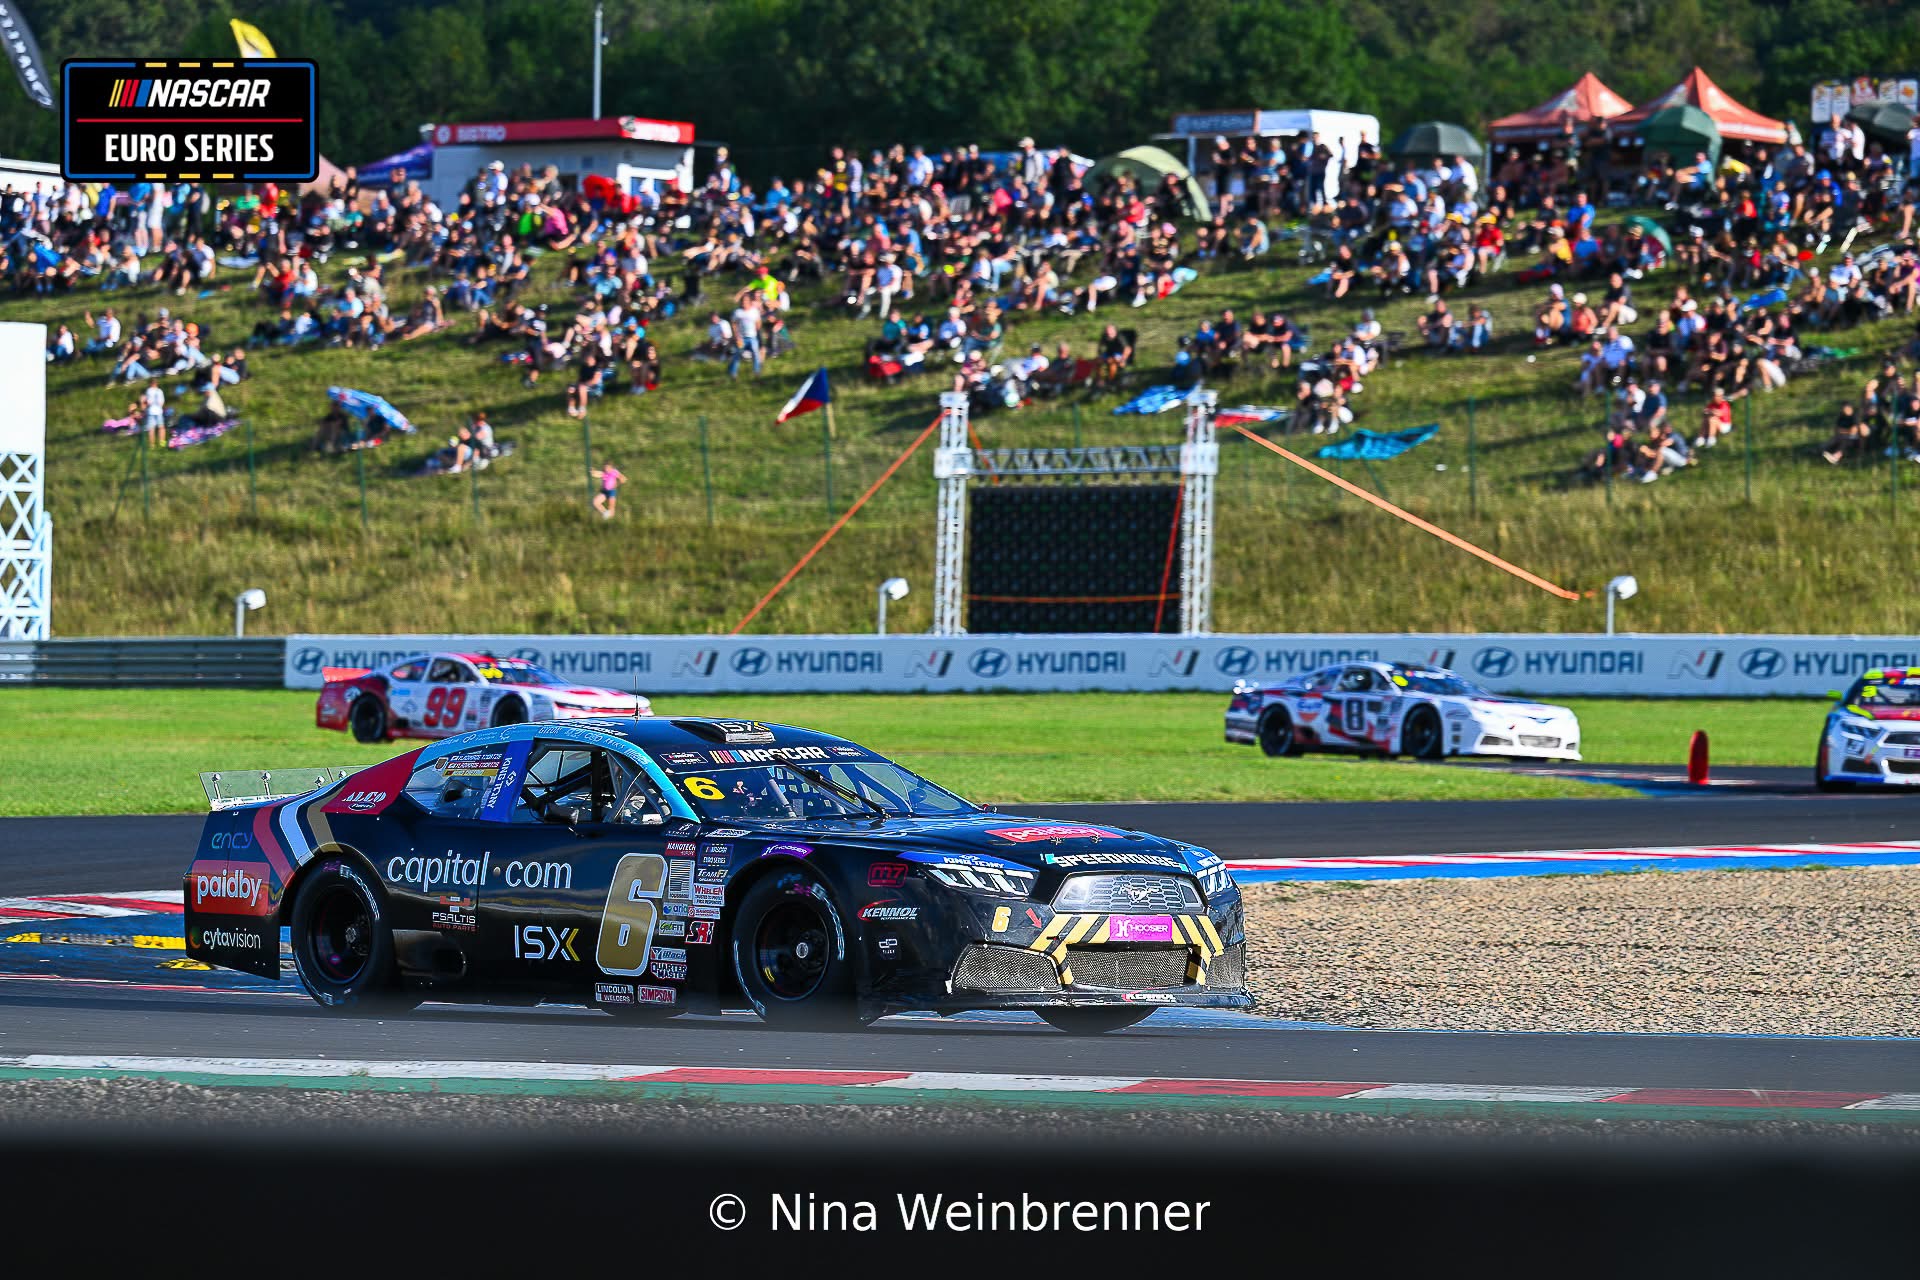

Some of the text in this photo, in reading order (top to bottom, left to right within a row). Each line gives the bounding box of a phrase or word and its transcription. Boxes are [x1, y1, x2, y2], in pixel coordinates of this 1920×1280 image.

[550, 651, 651, 673] HYUNDAI
[775, 651, 883, 673] HYUNDAI
[1017, 651, 1126, 673] HYUNDAI
[1525, 650, 1643, 674] HYUNDAI
[424, 687, 467, 728] 99
[742, 746, 830, 762] NASCAR
[341, 791, 387, 802] ALCO
[683, 777, 725, 800] 6
[667, 843, 697, 851] NANOTECH
[197, 869, 263, 906] paidby
[432, 912, 476, 924] PSALTIS
[596, 853, 669, 976] 6
[862, 907, 917, 918] KENNOL
[990, 906, 1011, 933] 6
[203, 928, 261, 950] cytavision
[1129, 924, 1169, 933] HOOSIER
[597, 984, 628, 994] LINCOLN
[603, 994, 631, 1003] WELDERS
[641, 989, 674, 1003] SIMPSON
